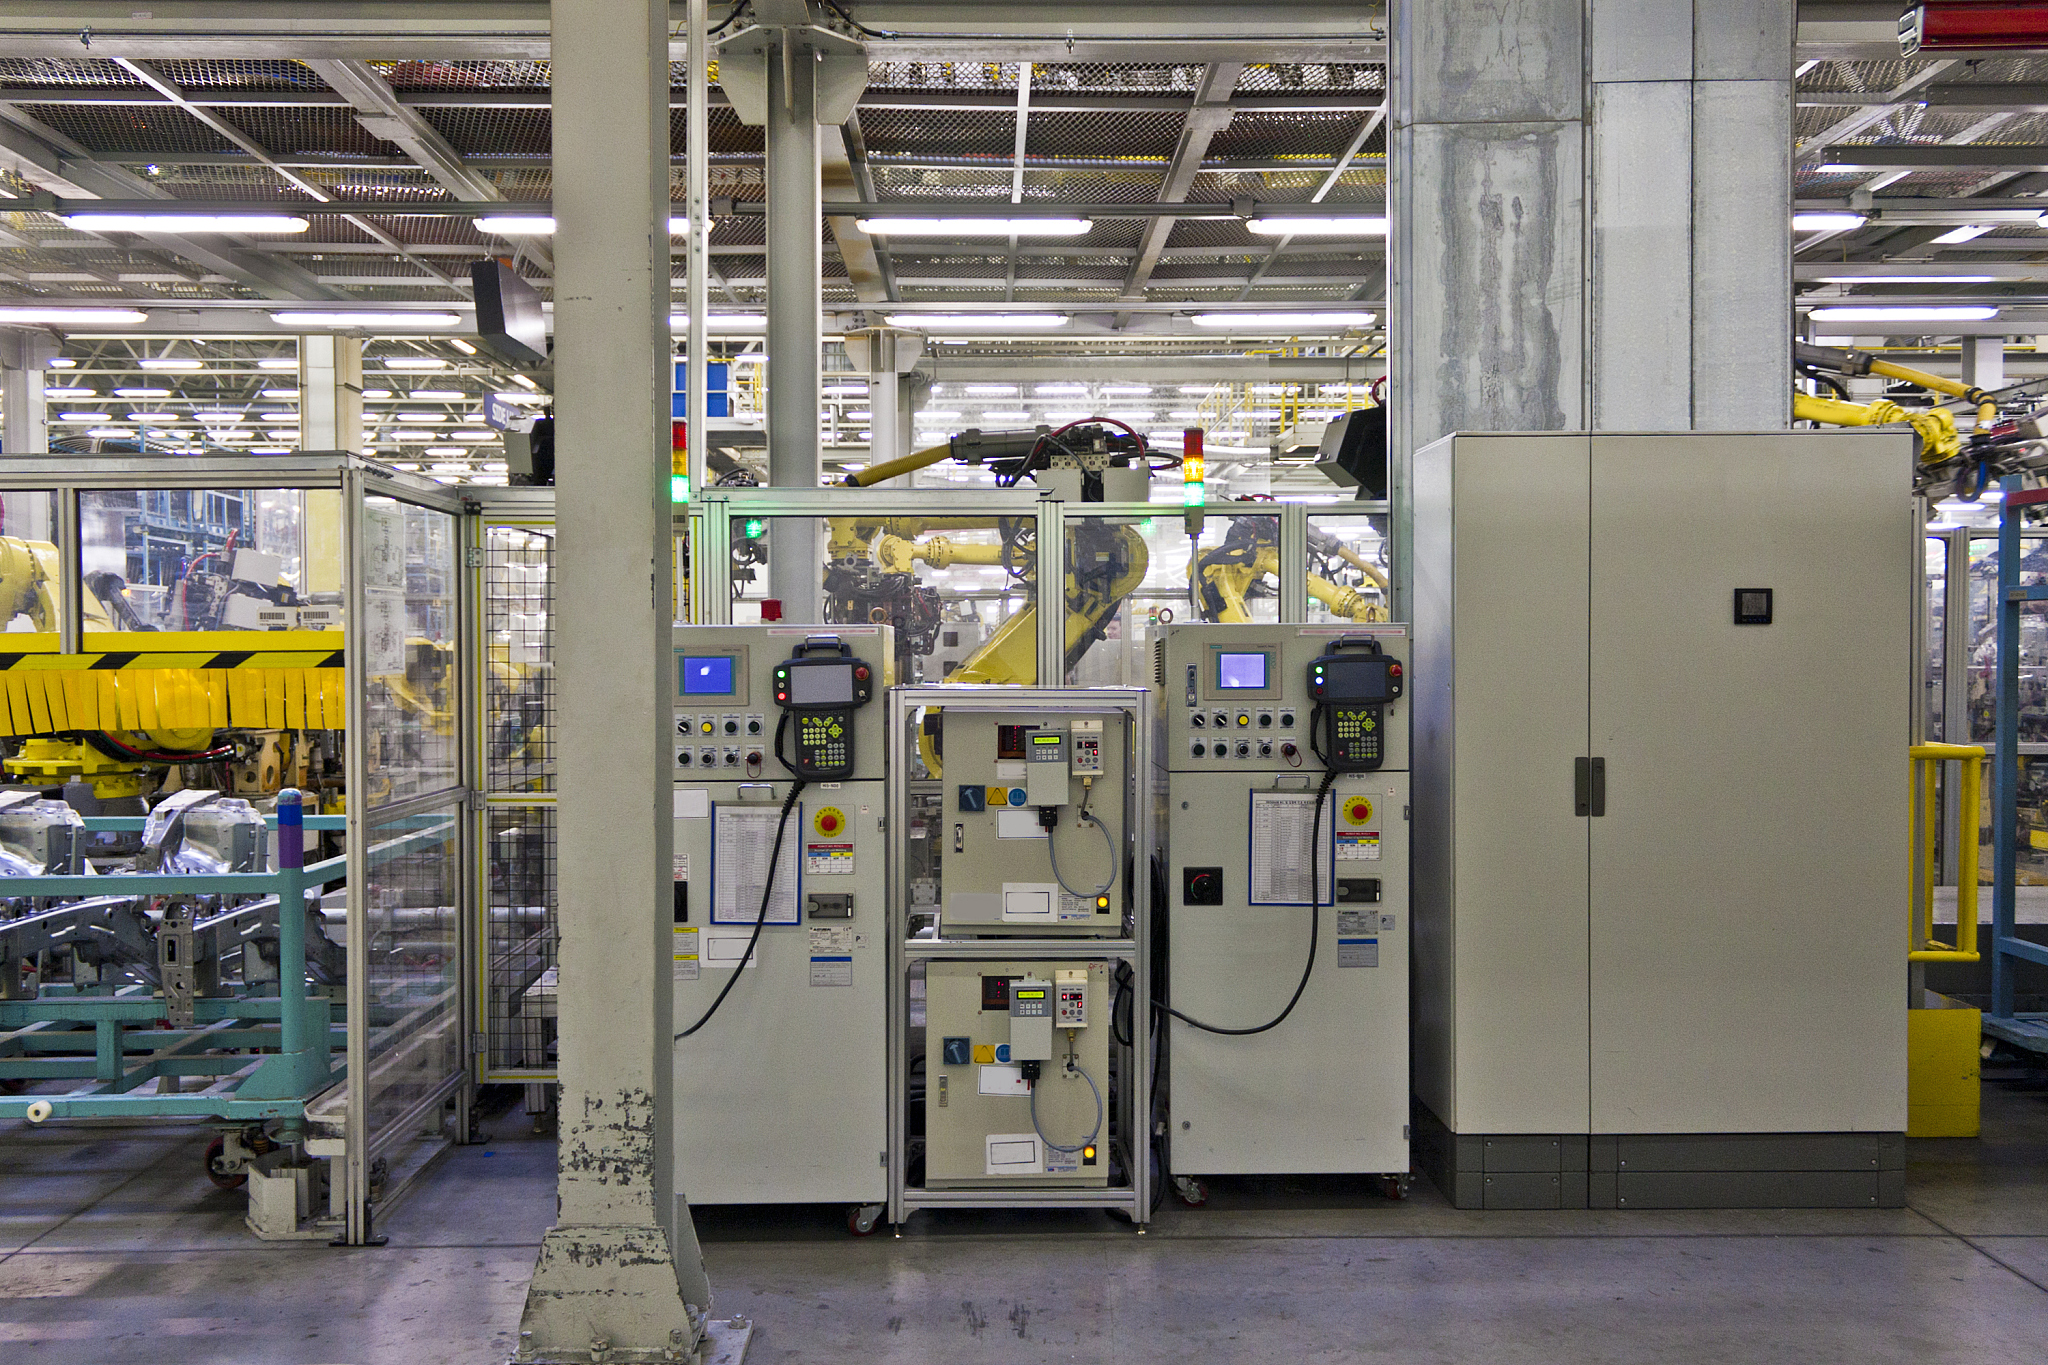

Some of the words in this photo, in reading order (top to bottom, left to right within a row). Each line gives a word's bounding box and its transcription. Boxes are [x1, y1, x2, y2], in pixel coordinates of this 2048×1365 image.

[492, 403, 506, 425] SIDE
[1344, 797, 1372, 812] EMERGENCY
[815, 807, 844, 822] EMERGENCY
